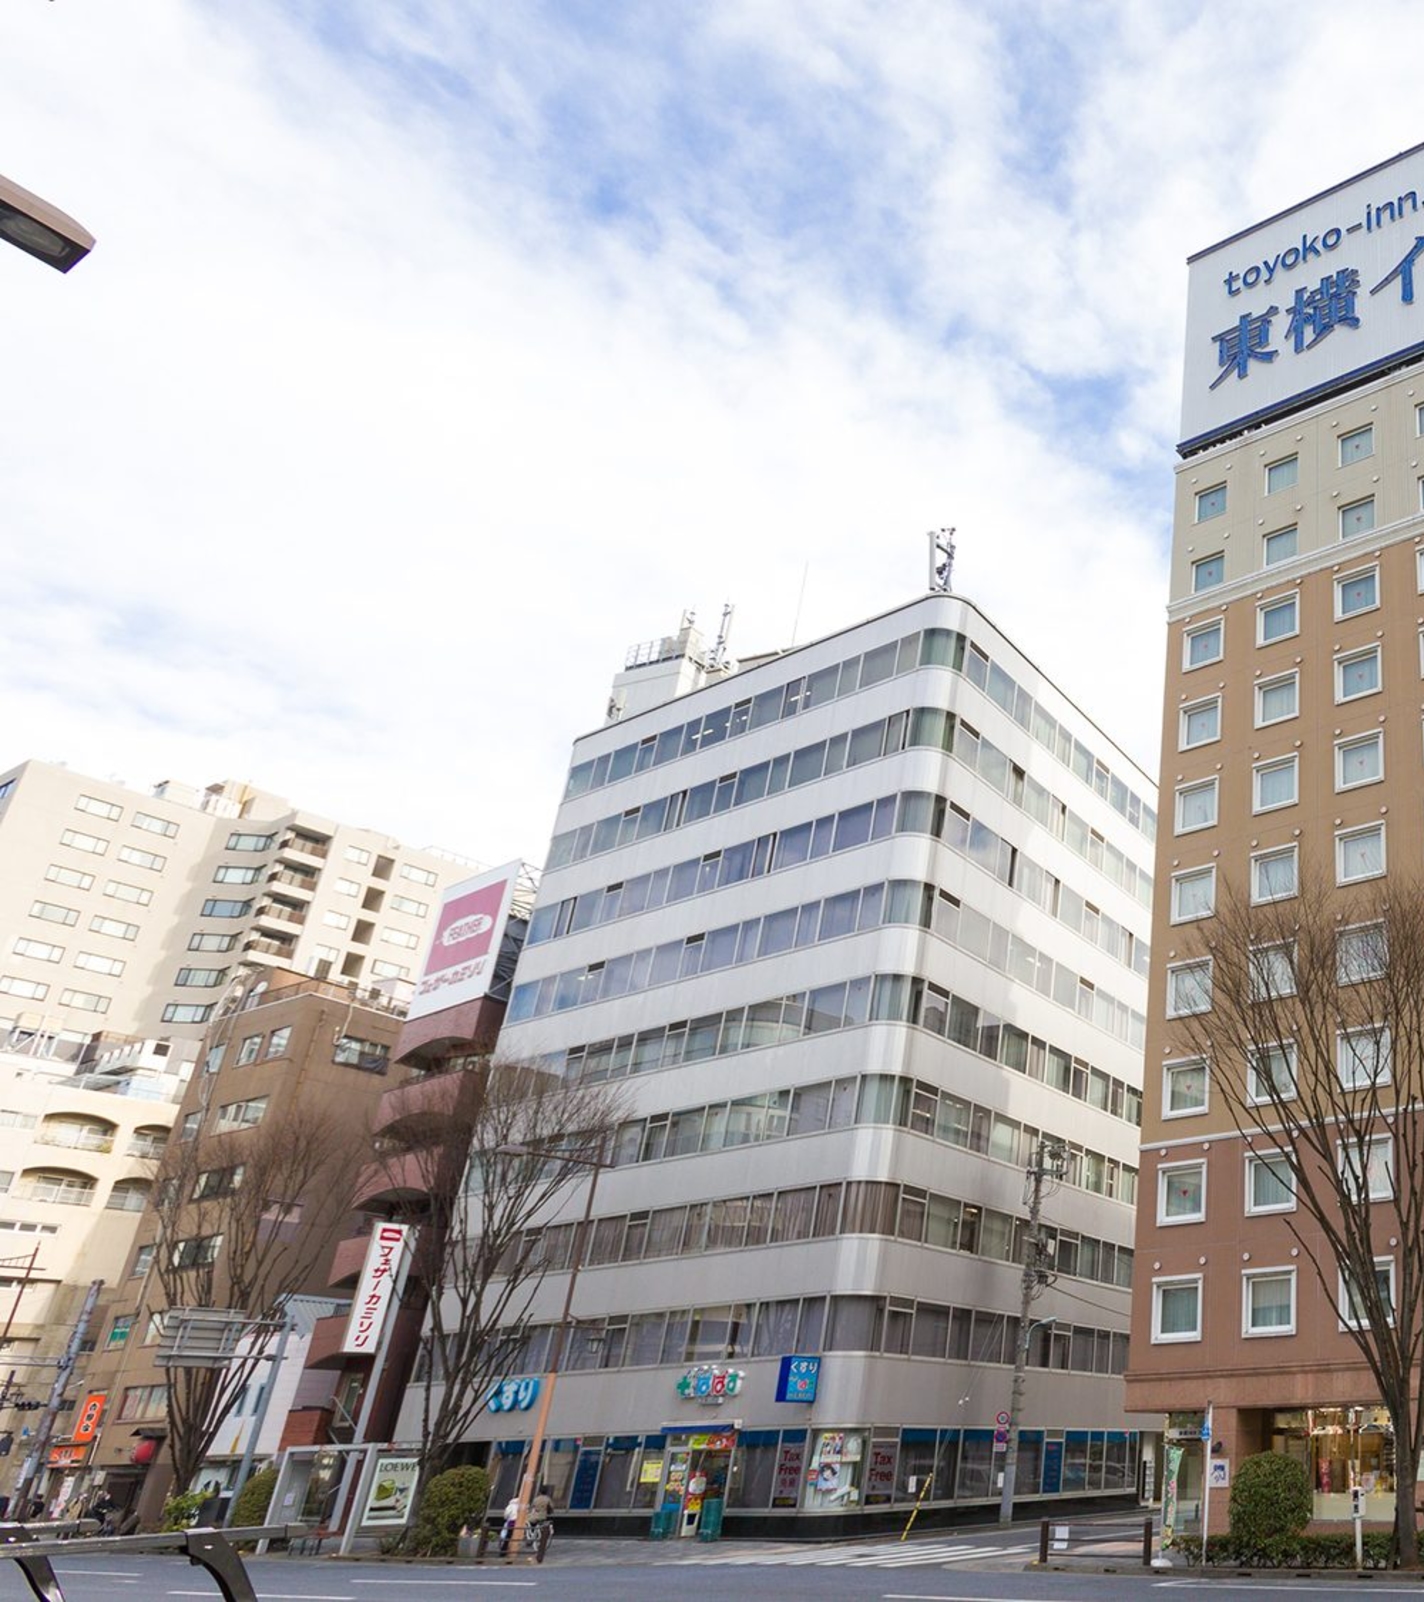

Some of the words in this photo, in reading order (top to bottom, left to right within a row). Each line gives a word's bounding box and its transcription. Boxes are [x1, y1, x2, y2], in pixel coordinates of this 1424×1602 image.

[354, 1245, 394, 1347] フェザーカミソリ
[790, 1361, 818, 1374] くすり
[379, 1461, 417, 1473] LOEWE
